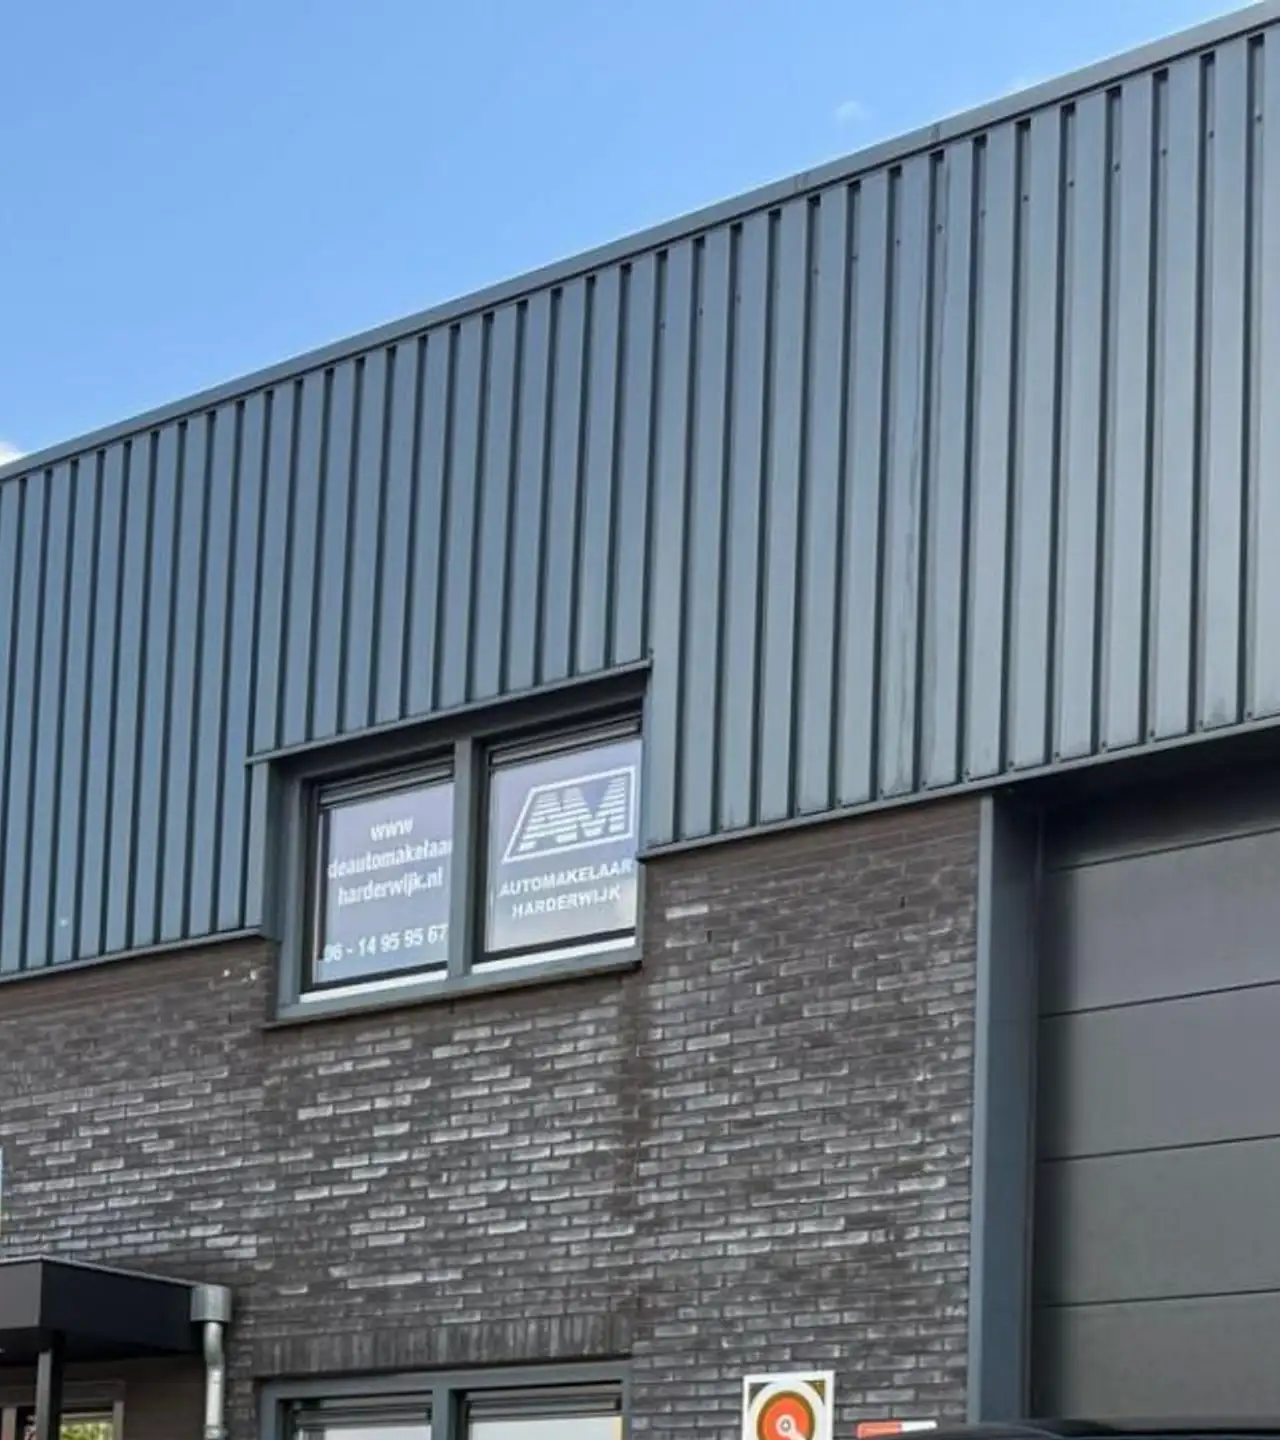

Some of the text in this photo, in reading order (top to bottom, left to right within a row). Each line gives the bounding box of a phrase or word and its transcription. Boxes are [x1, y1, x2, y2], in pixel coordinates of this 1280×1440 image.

[338, 866, 443, 907] harderwijk.nl
[499, 856, 634, 898] AUTOMAKELAAR
[511, 884, 622, 918] HARDERWIJK
[358, 935, 376, 957] 14
